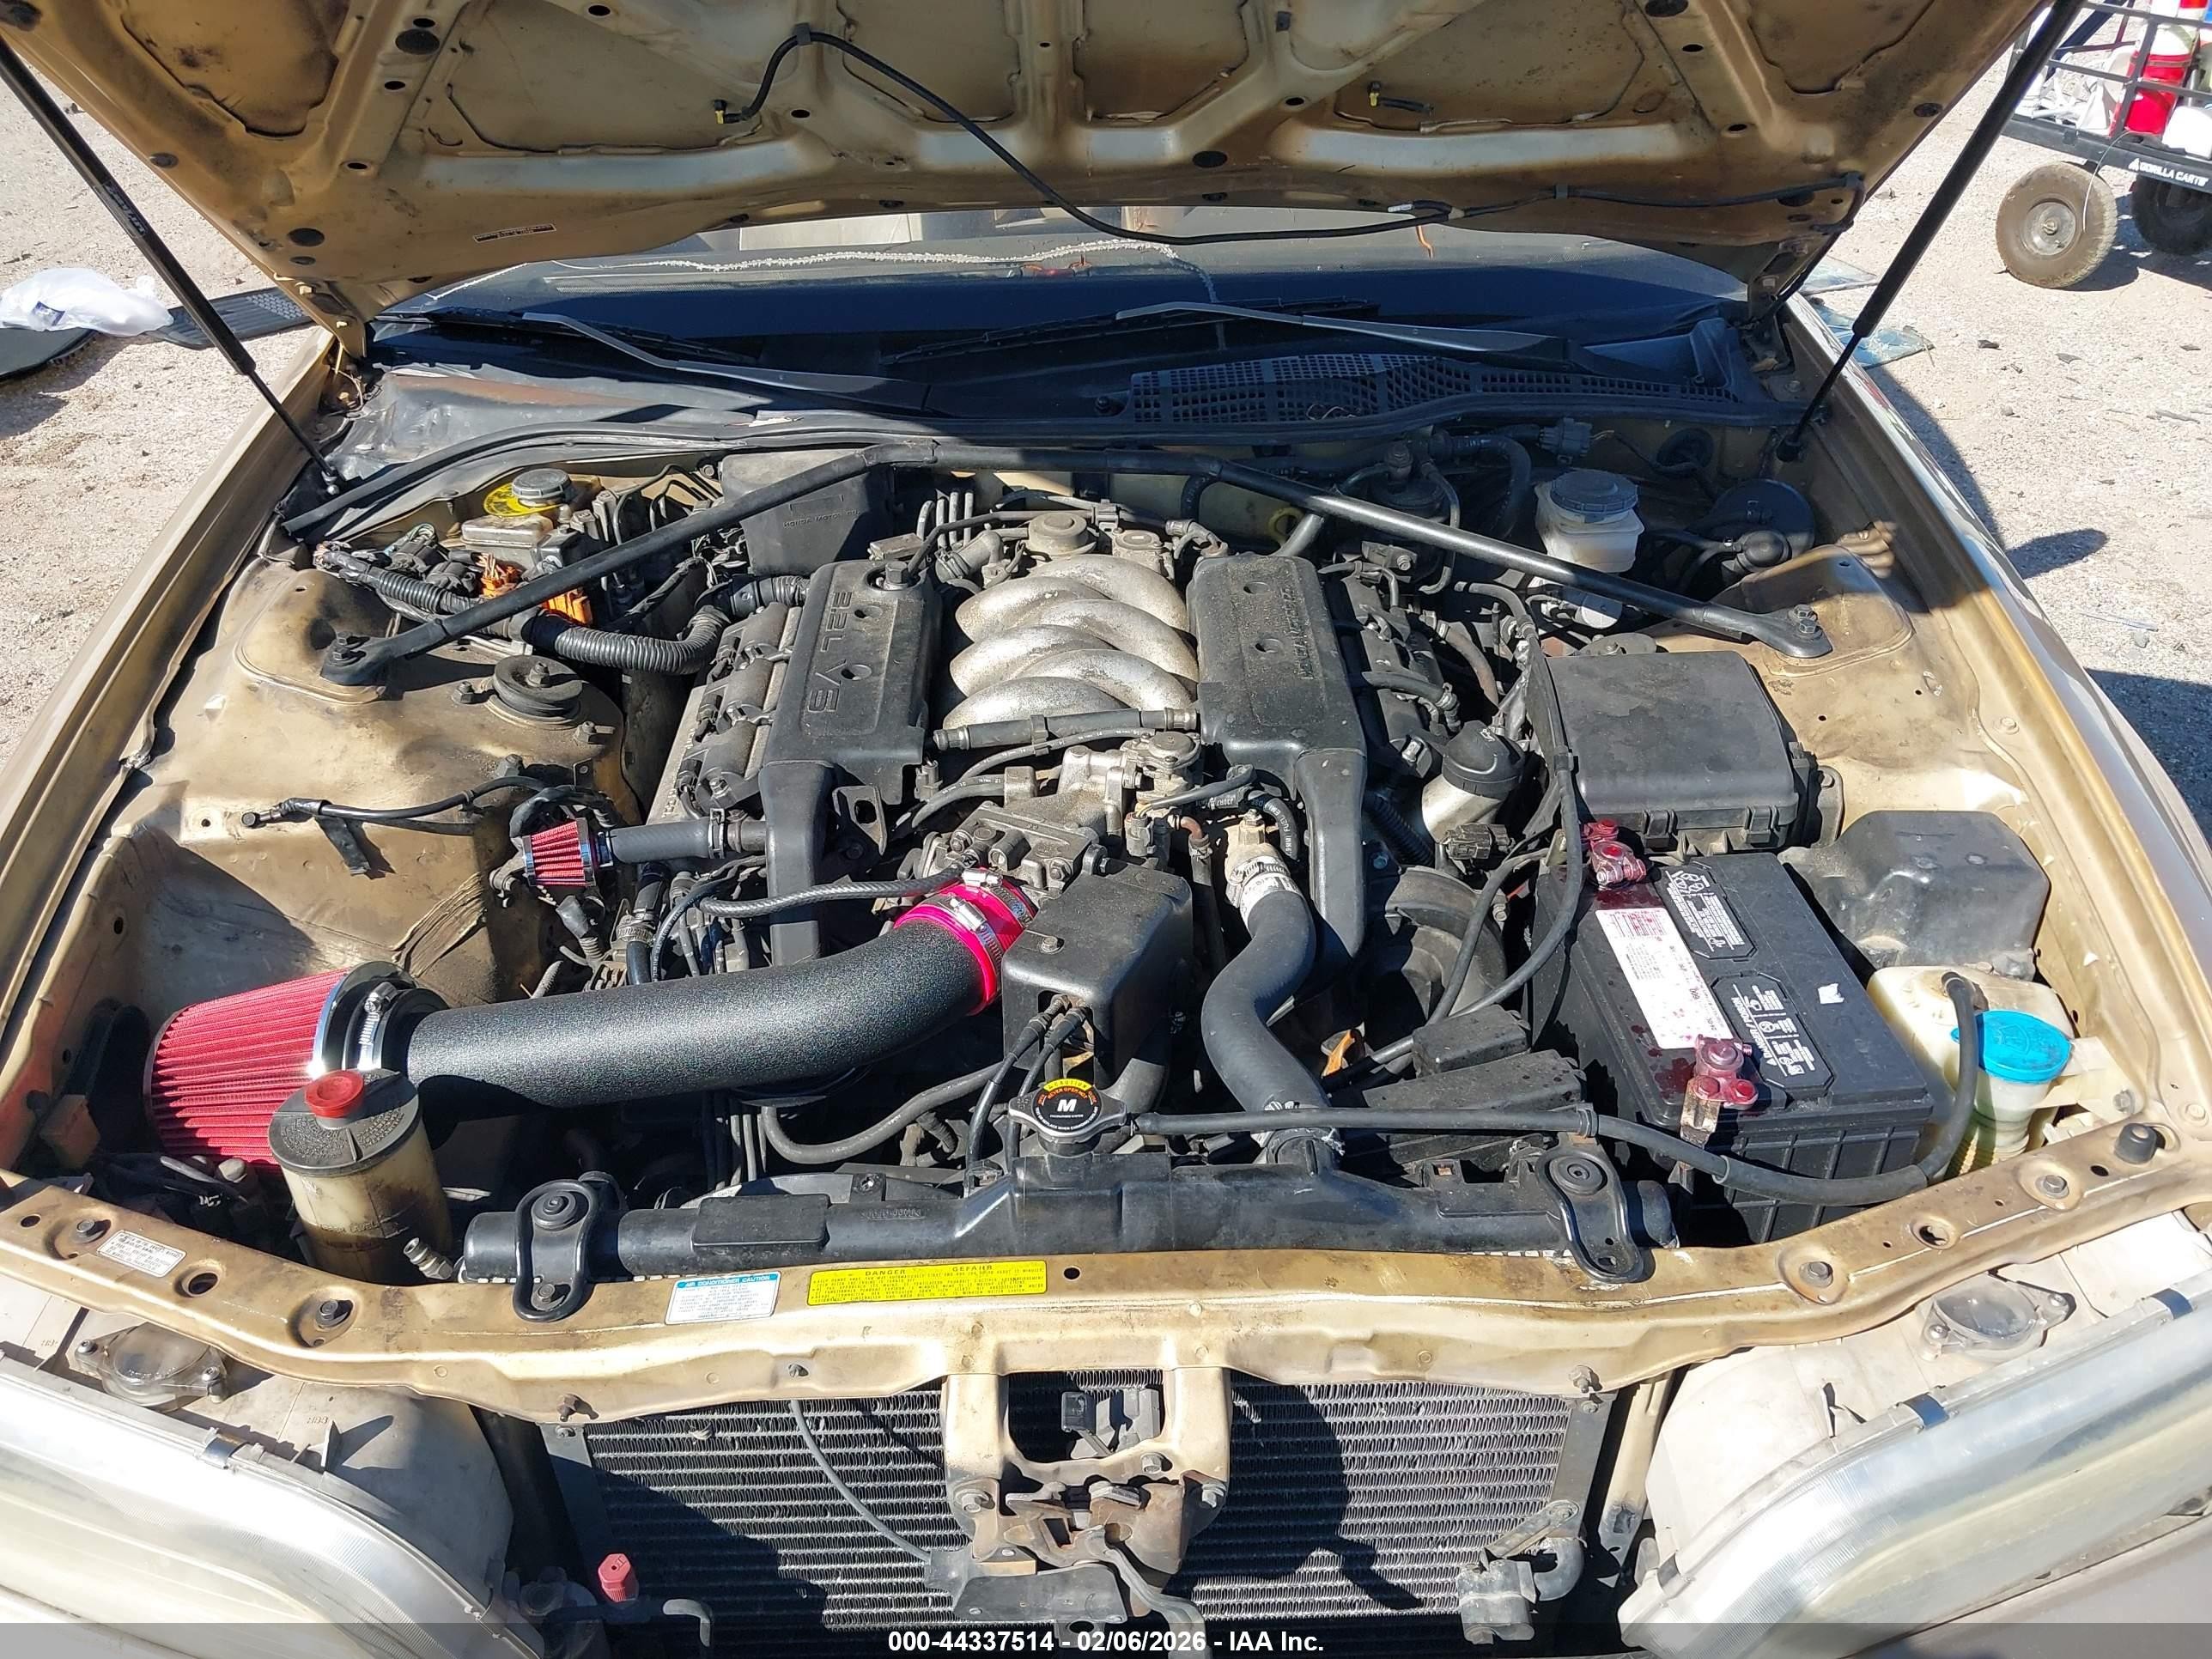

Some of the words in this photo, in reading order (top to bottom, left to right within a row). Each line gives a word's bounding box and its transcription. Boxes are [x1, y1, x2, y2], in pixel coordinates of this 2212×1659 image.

[807, 659, 848, 714] V6
[1054, 1080, 1088, 1089] CAUTION
[1057, 1099, 1078, 1112] M
[951, 1264, 993, 1273] GEFAHR
